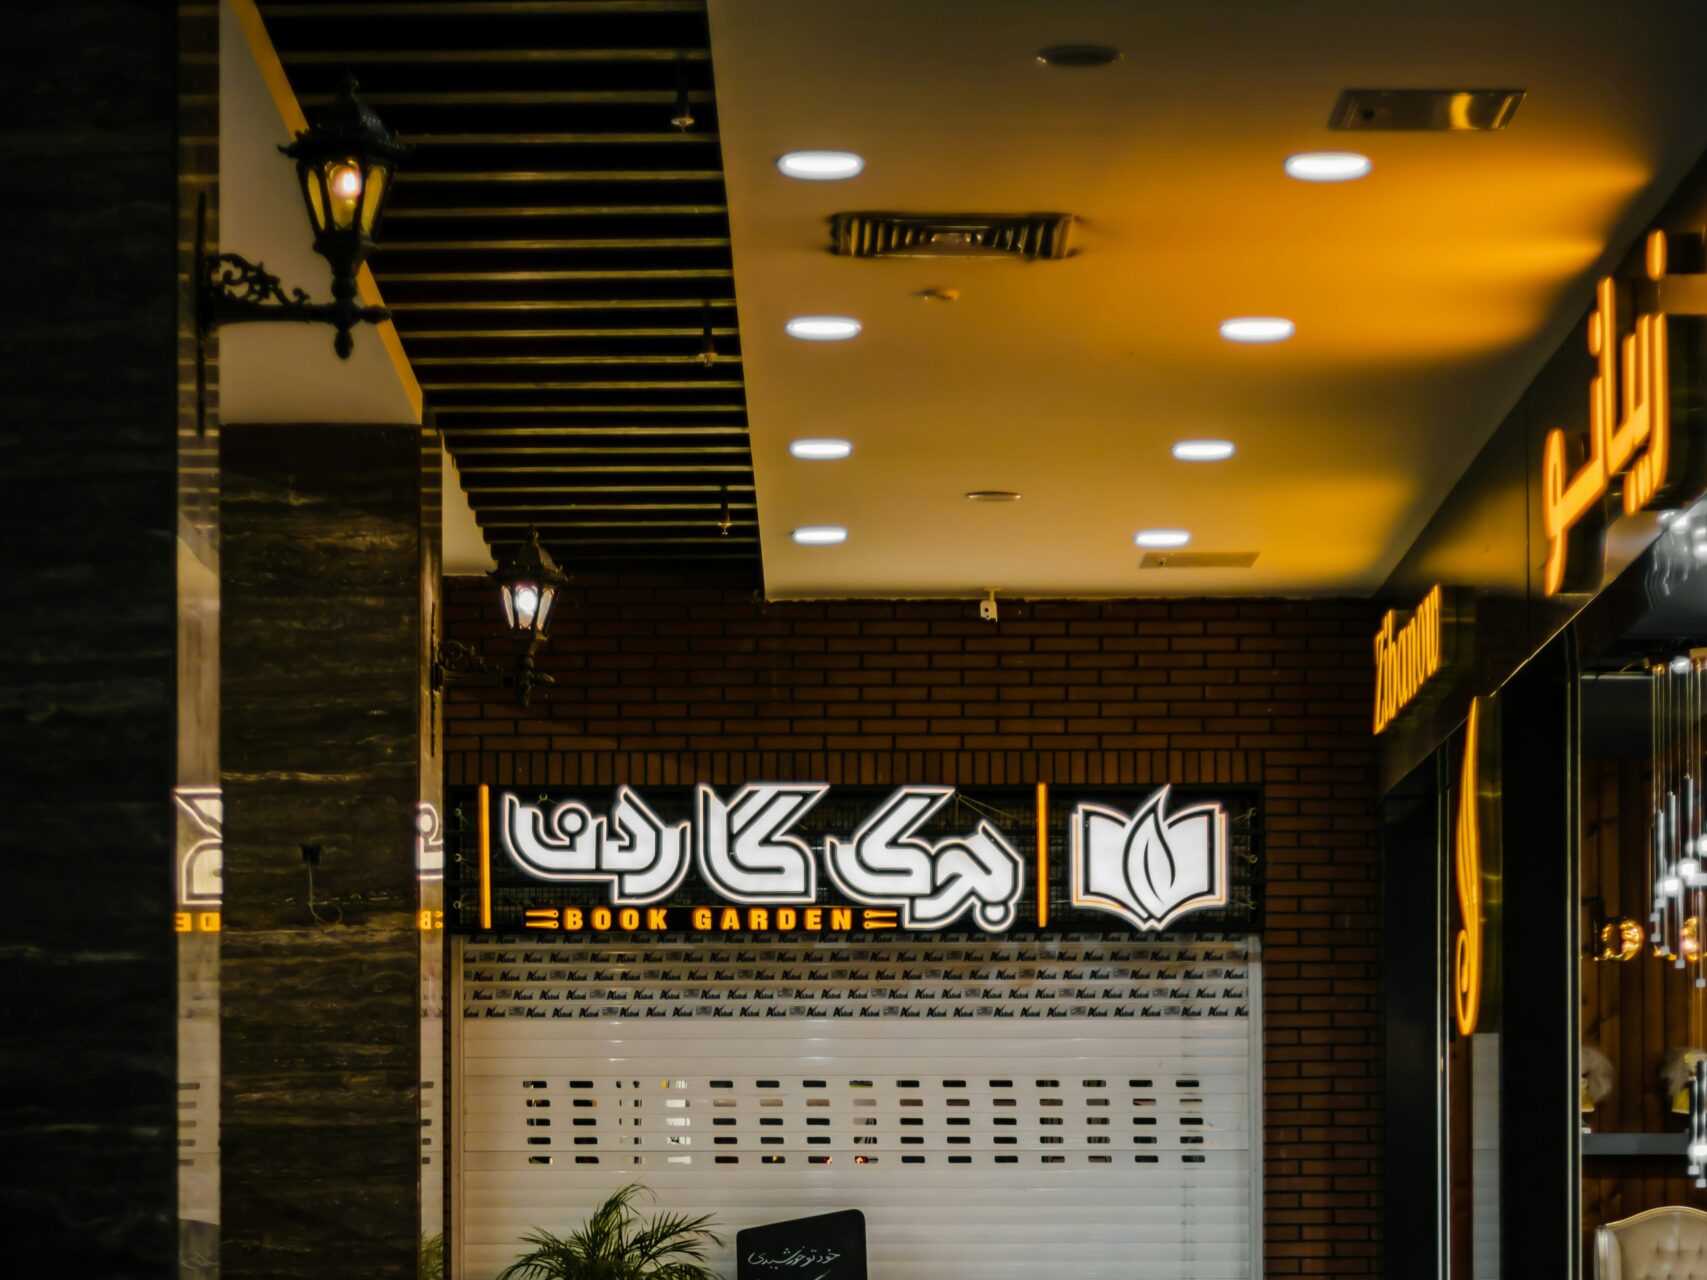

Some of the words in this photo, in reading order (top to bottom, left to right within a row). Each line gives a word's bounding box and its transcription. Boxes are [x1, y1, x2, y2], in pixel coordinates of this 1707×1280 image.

[500, 783, 830, 904] گاردن
[826, 783, 1025, 932] بوک
[563, 908, 669, 931] BOOK
[695, 908, 854, 931] GARDEN
